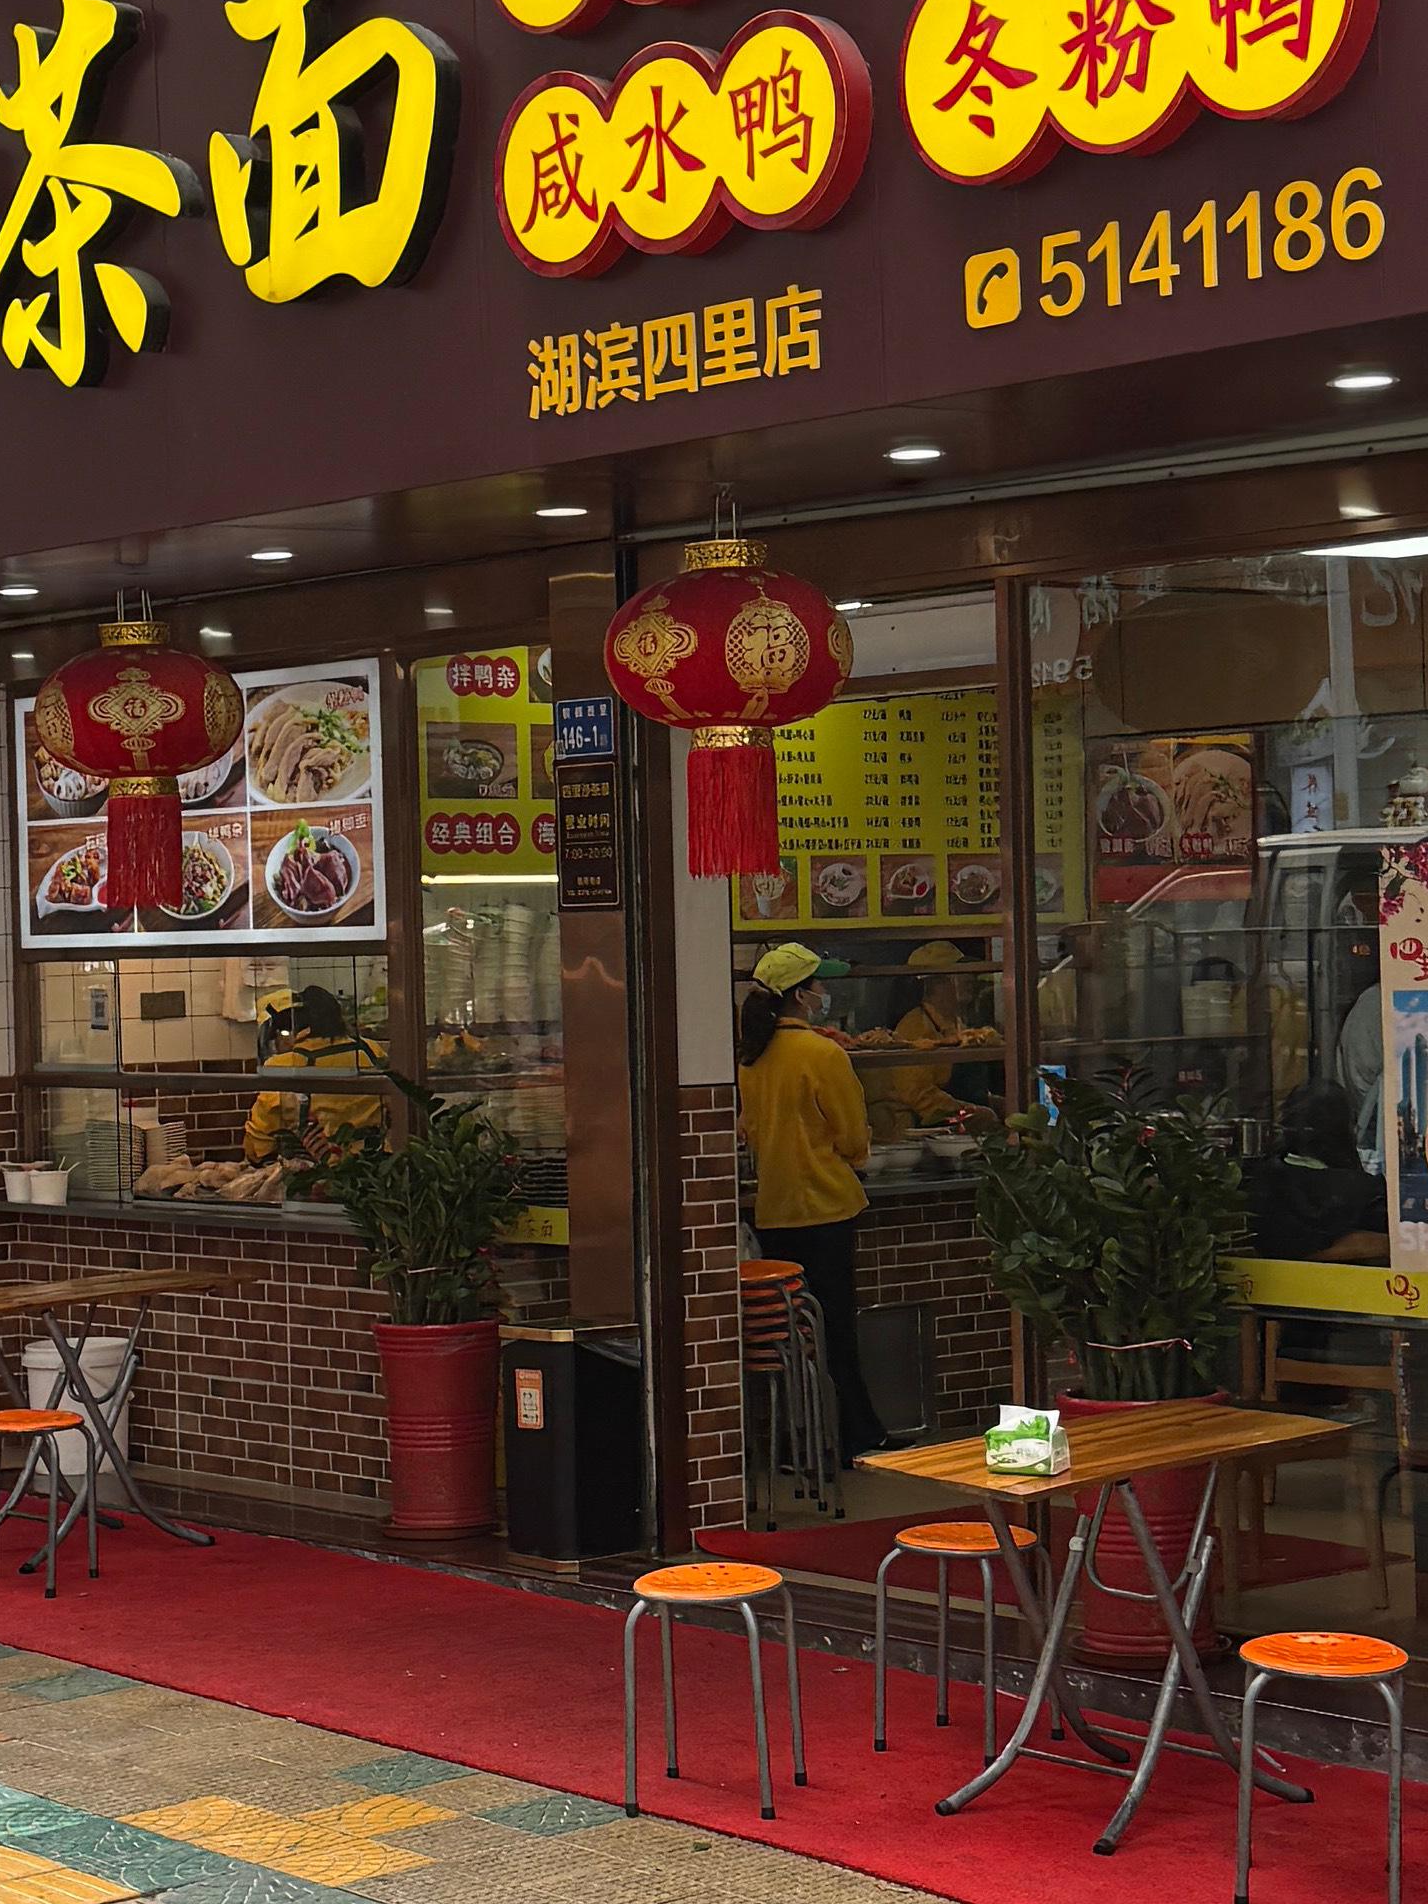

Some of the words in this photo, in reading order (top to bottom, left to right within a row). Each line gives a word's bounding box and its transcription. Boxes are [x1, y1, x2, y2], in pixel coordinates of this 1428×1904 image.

[521, 48, 817, 235] 咸水鸭
[1038, 166, 1386, 318] 5141186
[527, 284, 823, 419] 湖滨四里店
[451, 663, 517, 690] 拌鸭杂
[431, 822, 516, 846] 经典组合
